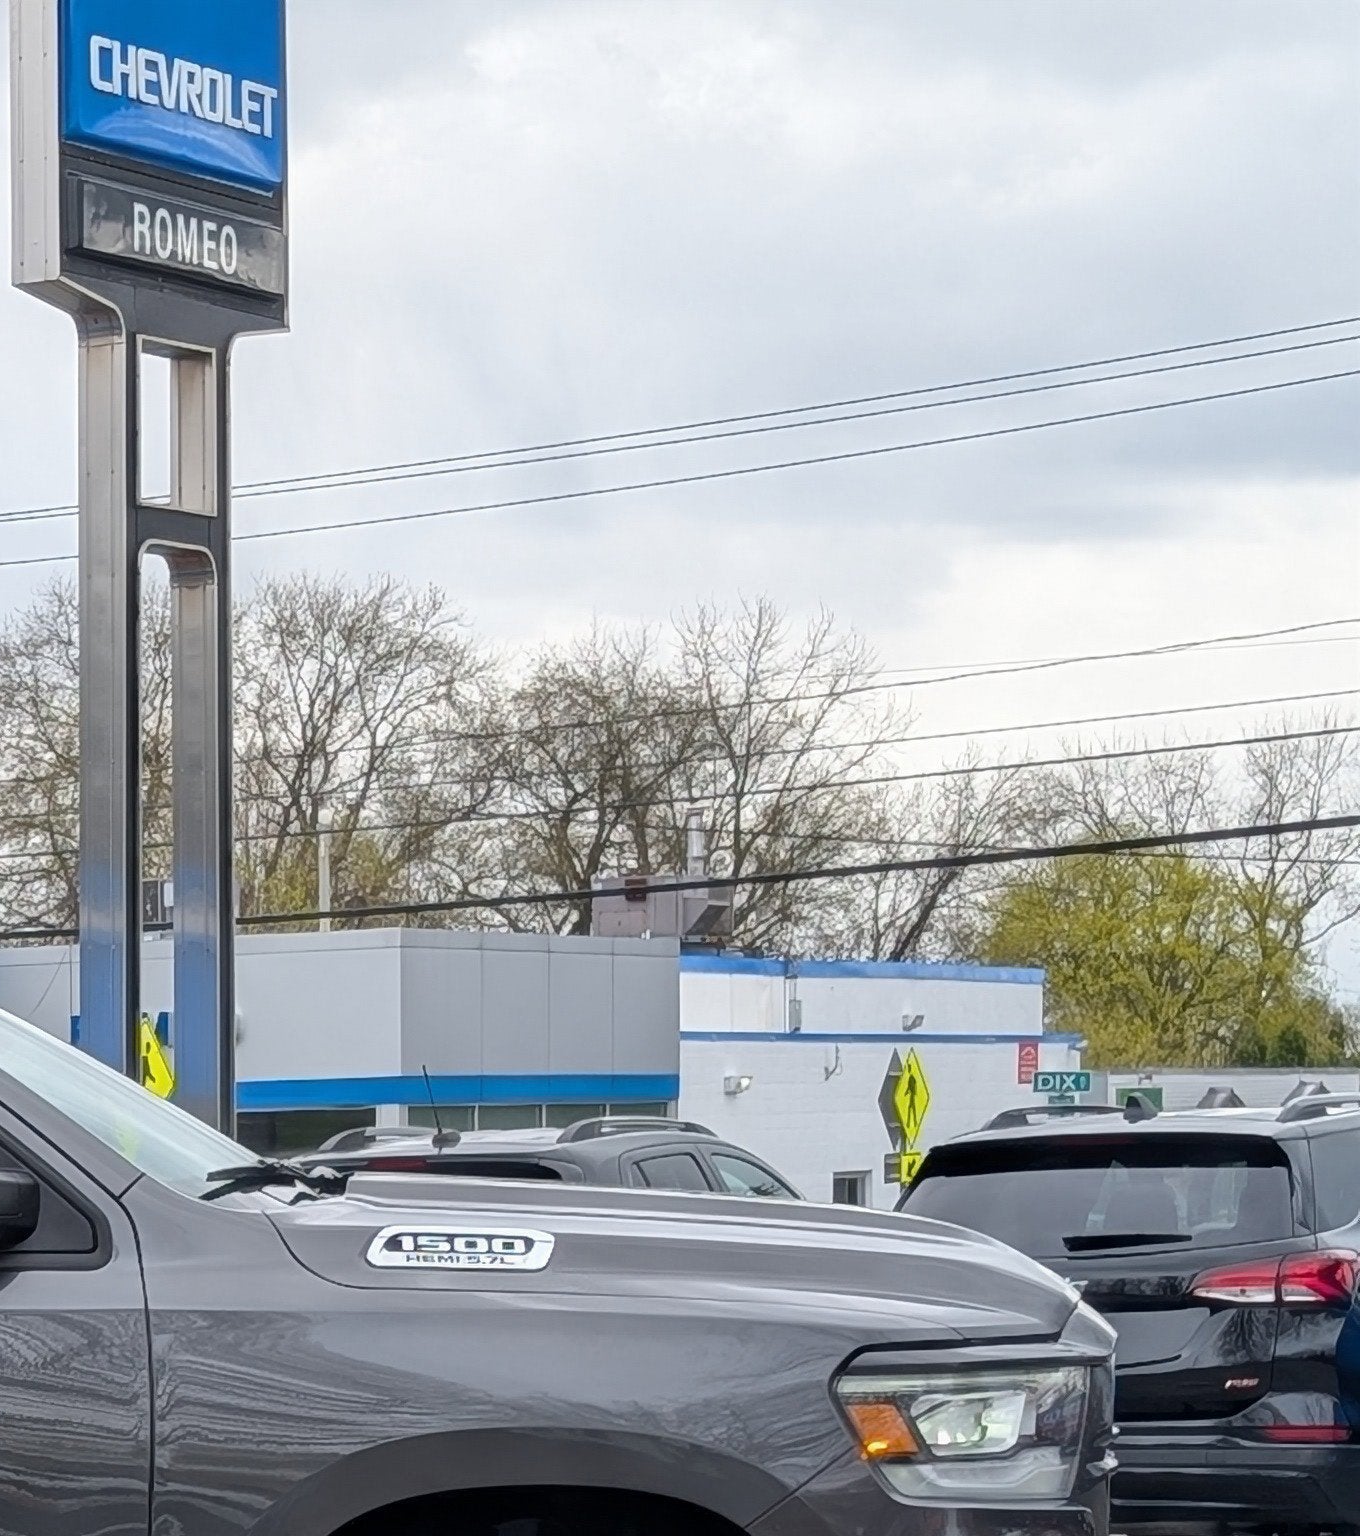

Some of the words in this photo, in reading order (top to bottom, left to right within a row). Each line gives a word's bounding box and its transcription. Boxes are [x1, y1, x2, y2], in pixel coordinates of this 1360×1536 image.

[90, 35, 278, 139] CHEVROLET
[133, 202, 238, 275] ROMEO
[1038, 1074, 1076, 1090] DIX
[395, 1234, 526, 1254] 1500
[405, 1254, 461, 1264] HEMI
